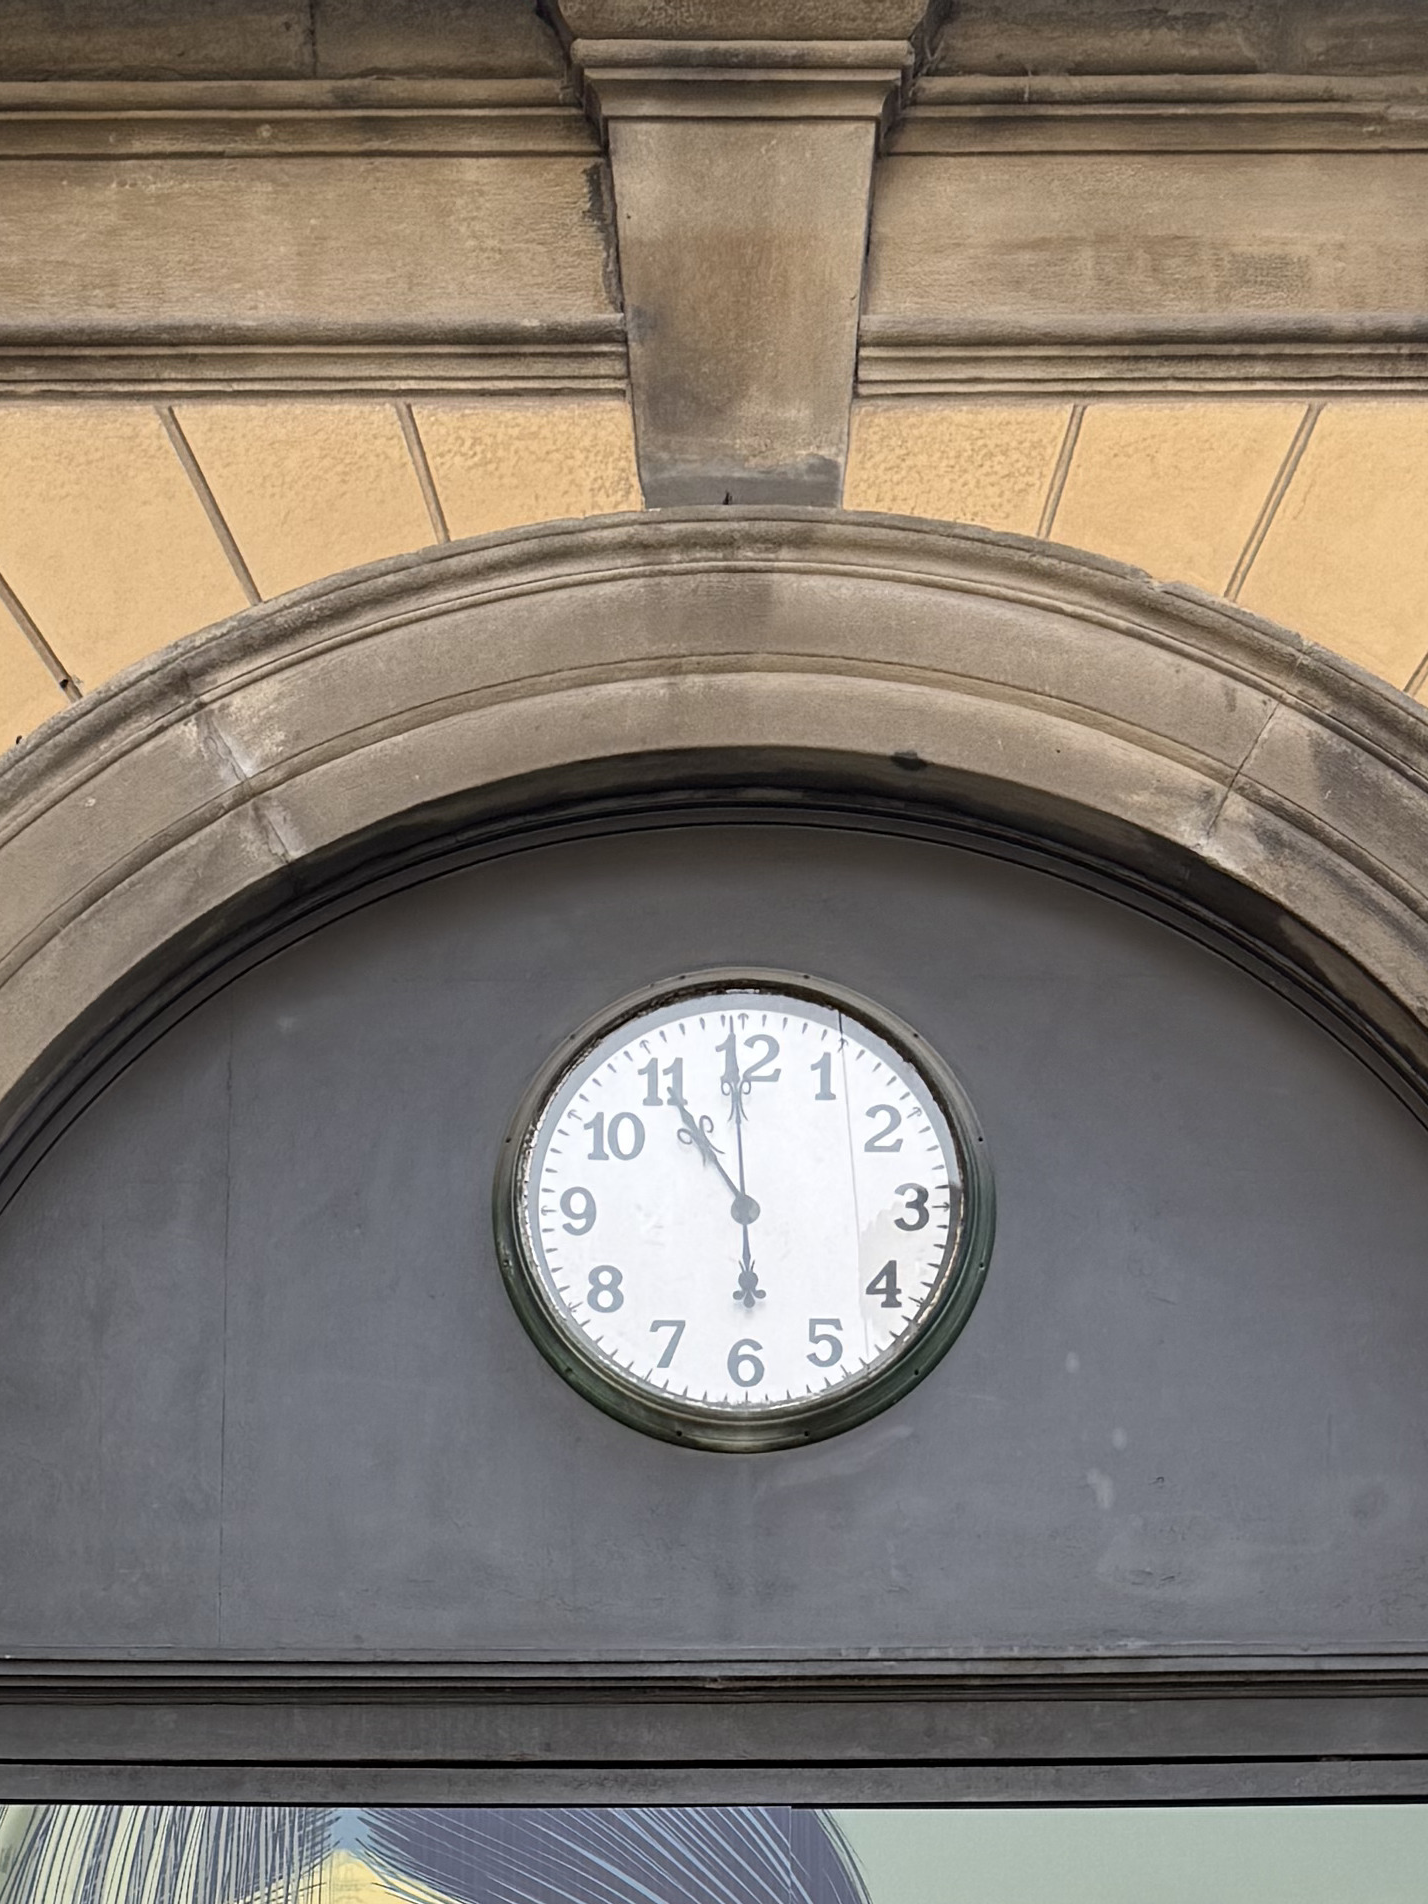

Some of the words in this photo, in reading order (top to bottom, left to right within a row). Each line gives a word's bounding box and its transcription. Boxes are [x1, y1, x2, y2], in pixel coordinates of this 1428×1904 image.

[638, 1057, 687, 1106] 11
[716, 1034, 781, 1082] 12
[811, 1052, 836, 1100] 1
[583, 1112, 645, 1160] 10
[864, 1104, 903, 1152] 2
[559, 1186, 597, 1235] 9
[894, 1182, 929, 1231] 3
[586, 1265, 624, 1313] 8
[866, 1260, 902, 1308] 4
[649, 1320, 686, 1368] 7
[727, 1338, 765, 1387] 6
[806, 1318, 843, 1367] 5
